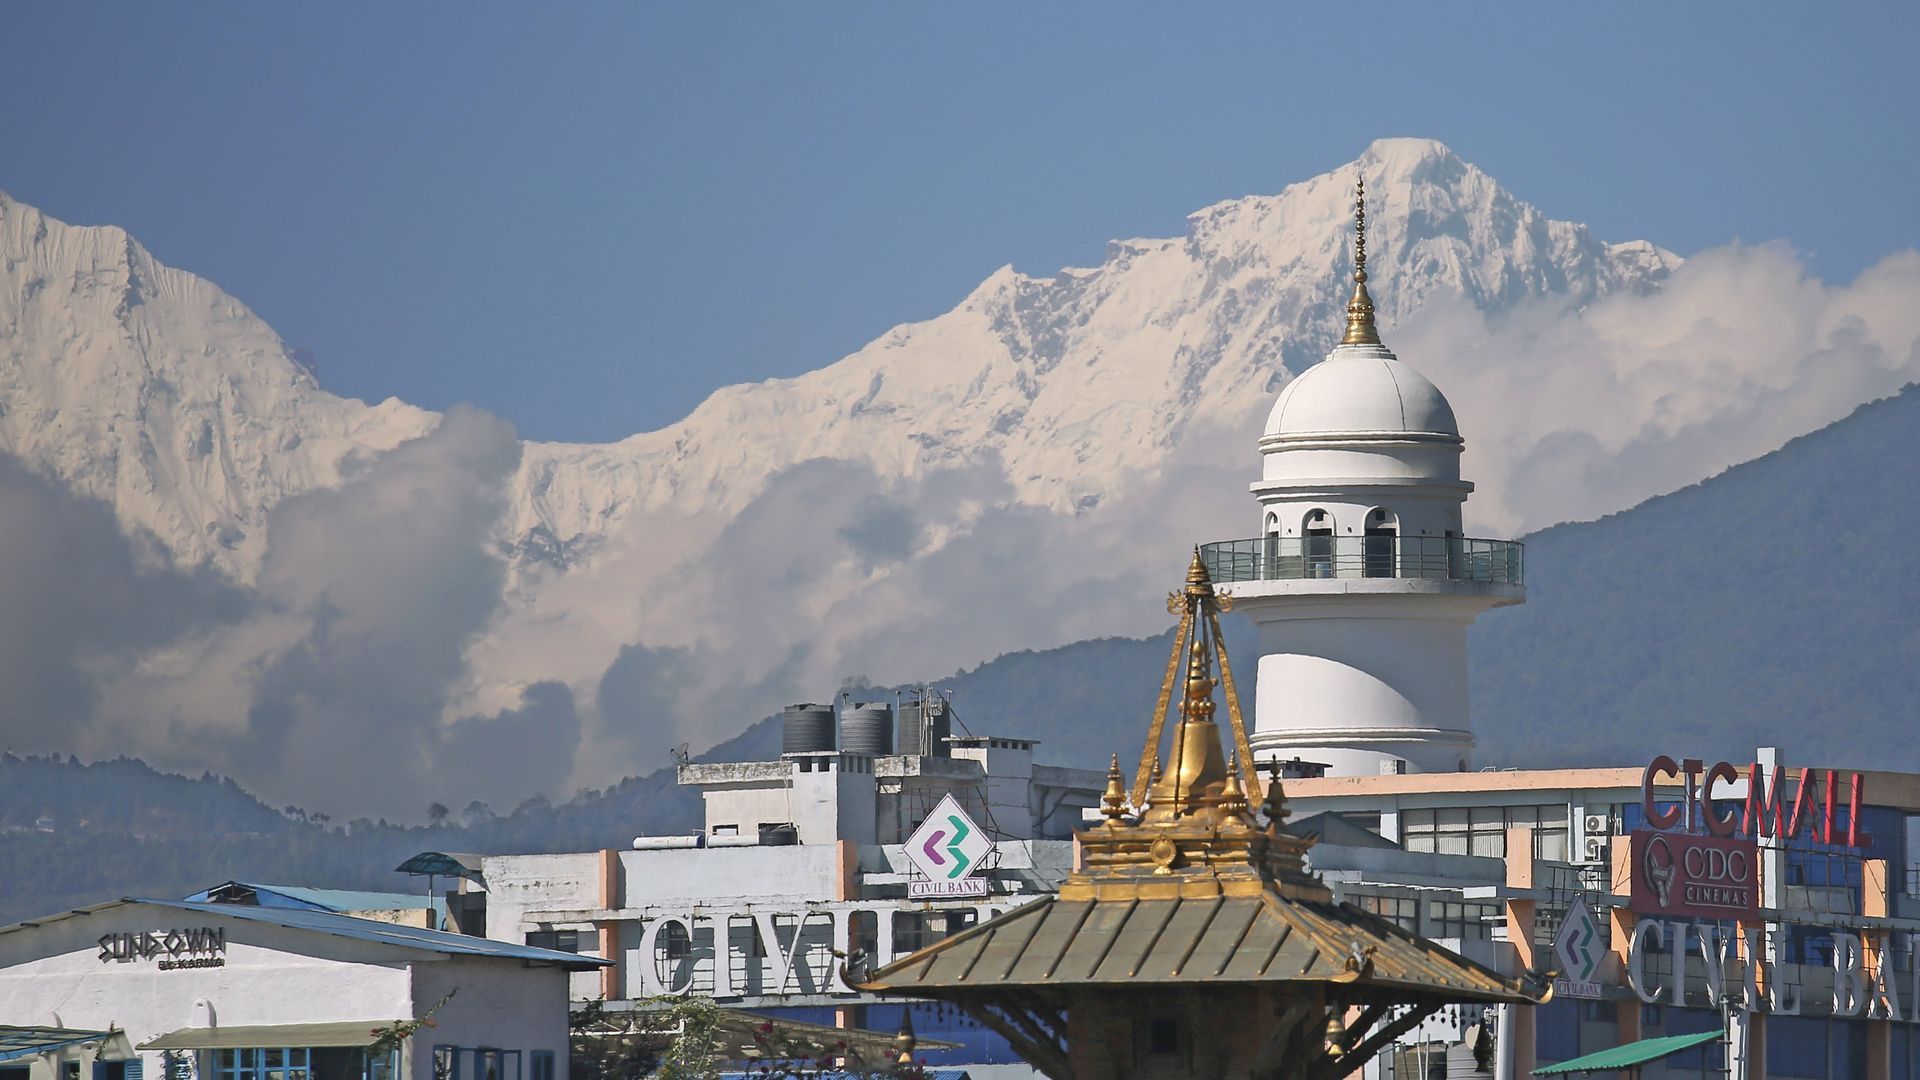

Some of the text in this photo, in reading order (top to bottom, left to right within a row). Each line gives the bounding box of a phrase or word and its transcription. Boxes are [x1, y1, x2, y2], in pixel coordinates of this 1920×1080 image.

[1642, 755, 1872, 848] CTC MALL
[1684, 846, 1748, 883] CDC
[912, 881, 981, 895] CIVIL BANK
[1686, 886, 1748, 906] CINEMAS
[98, 927, 226, 963] SUNDOWN
[177, 957, 225, 969] KARMA
[1627, 918, 1801, 1015] CIVIL
